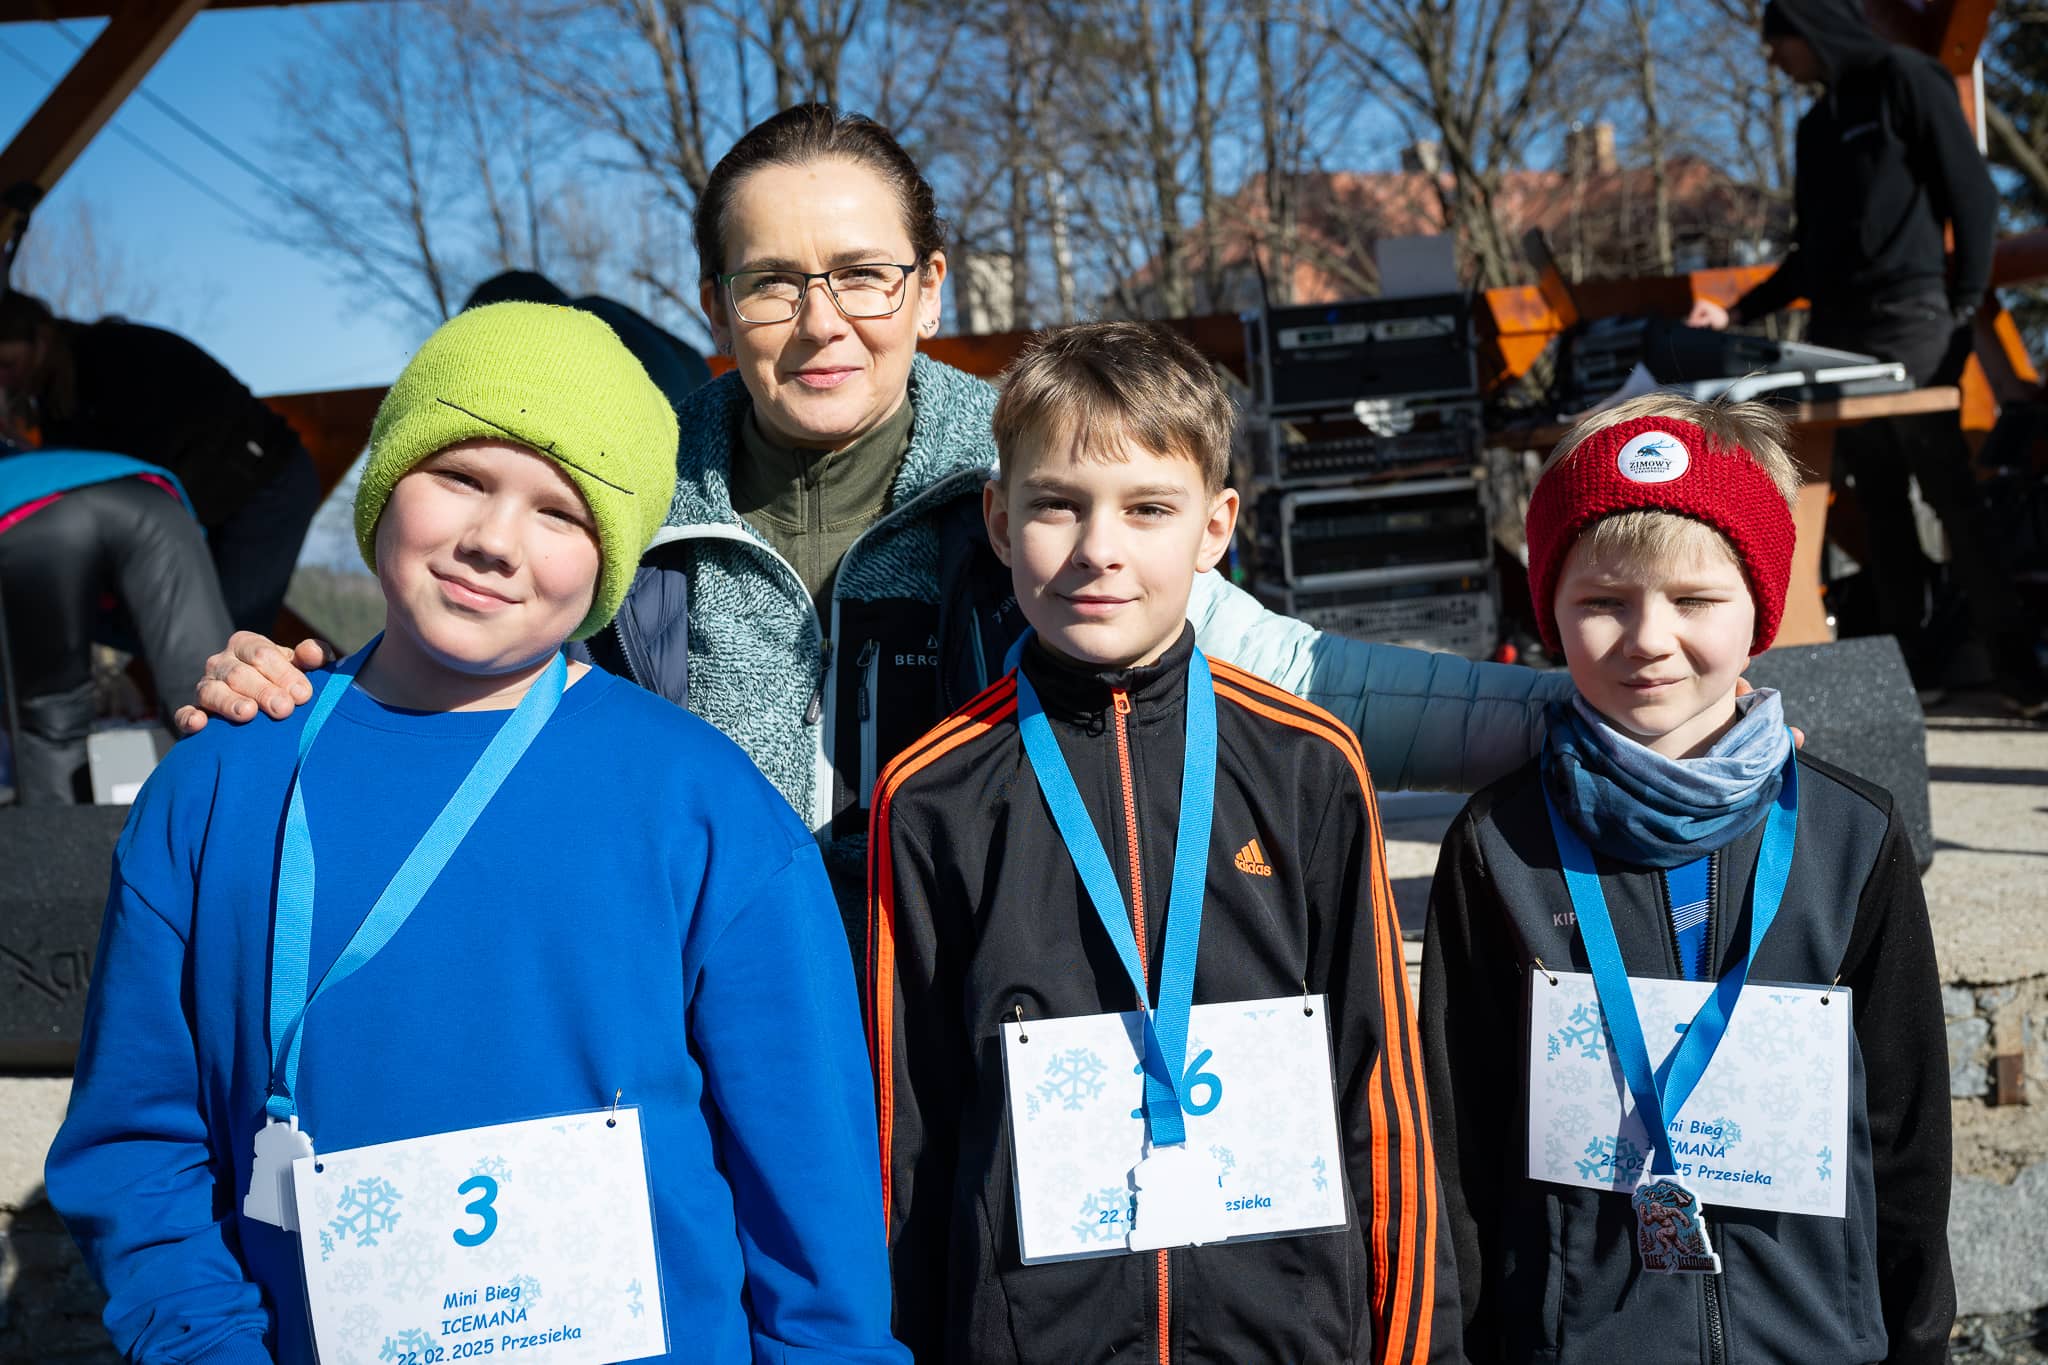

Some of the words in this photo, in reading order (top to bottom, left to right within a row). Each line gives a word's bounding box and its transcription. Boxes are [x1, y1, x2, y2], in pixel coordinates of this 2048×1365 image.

[1629, 460, 1672, 469] ZIMOWY
[895, 654, 938, 666] BERG
[1234, 859, 1272, 877] adidas
[1668, 1119, 1684, 1132] ni
[1690, 1120, 1723, 1140] Bieg
[1698, 1165, 1772, 1185] Przesieka
[453, 1175, 498, 1247] 3
[443, 1289, 477, 1309] Mini
[485, 1285, 520, 1302] Bieg
[441, 1307, 527, 1335] ICEMANA
[501, 1325, 582, 1350] Przesieka
